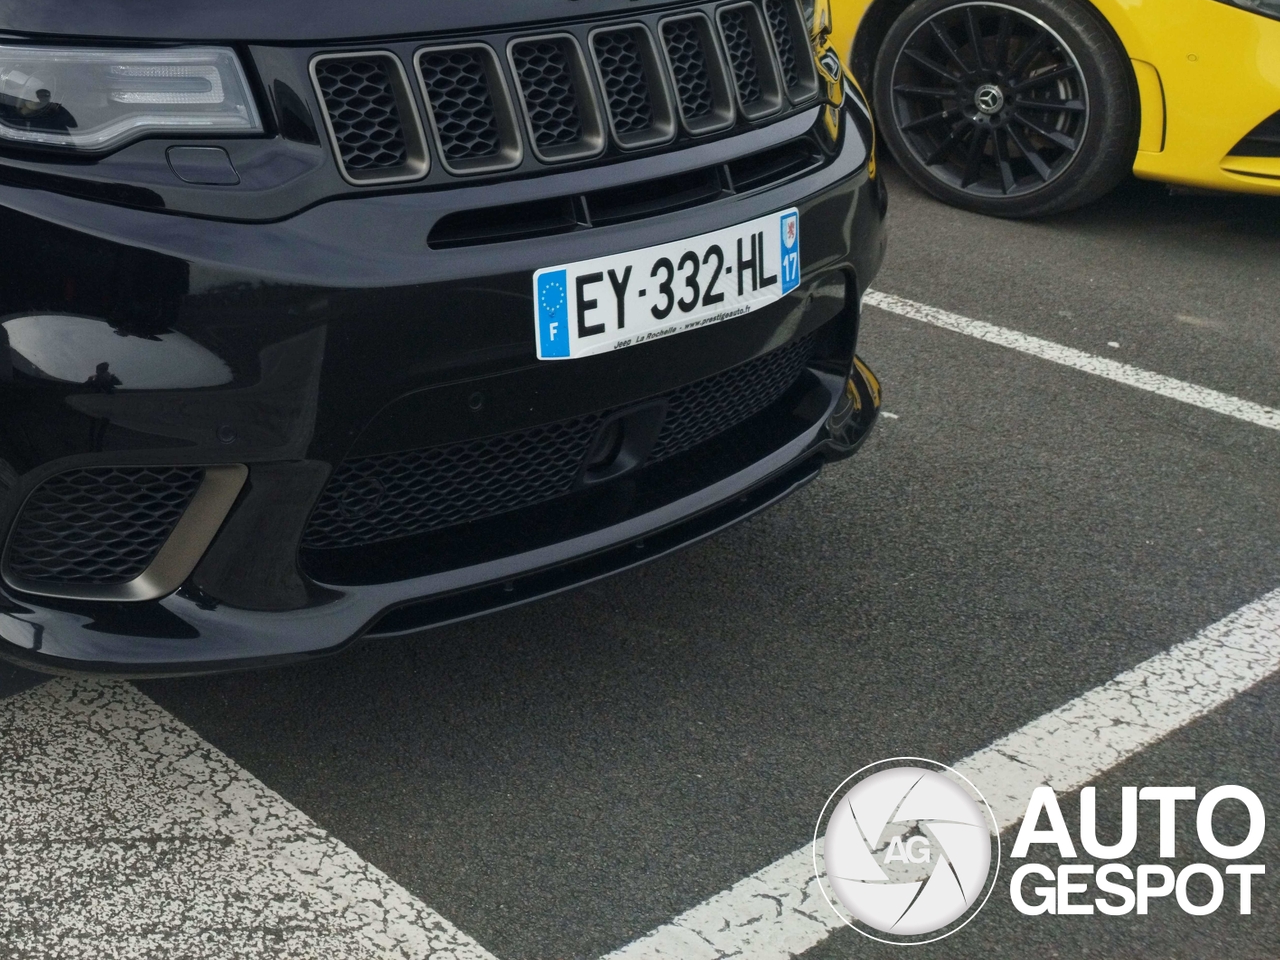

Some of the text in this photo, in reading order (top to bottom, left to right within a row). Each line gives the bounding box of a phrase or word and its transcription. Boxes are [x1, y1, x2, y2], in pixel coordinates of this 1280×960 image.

[783, 252, 797, 281] 17
[575, 231, 778, 339] EY-332-HL
[549, 322, 558, 341] F
[614, 340, 631, 349] Jeep
[636, 333, 645, 343] La
[646, 327, 677, 340] Rochelle
[684, 305, 751, 329] www.prestigeauto.fr
